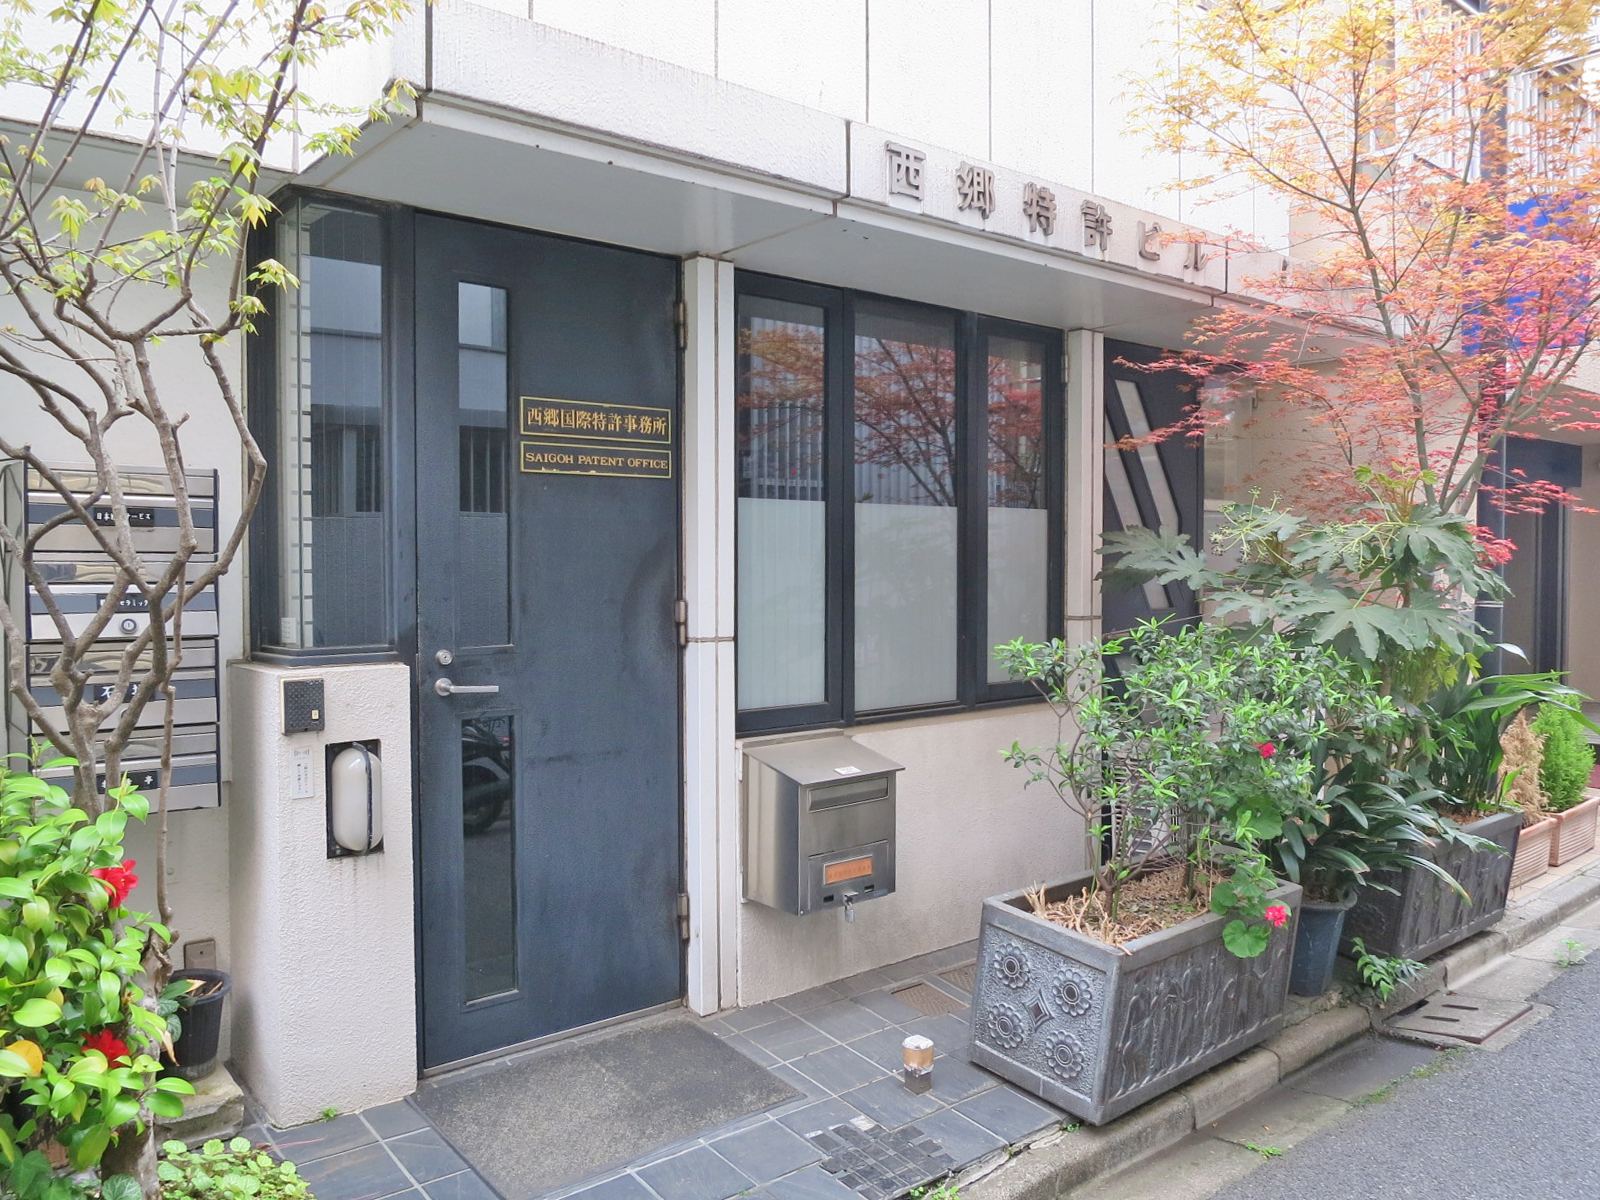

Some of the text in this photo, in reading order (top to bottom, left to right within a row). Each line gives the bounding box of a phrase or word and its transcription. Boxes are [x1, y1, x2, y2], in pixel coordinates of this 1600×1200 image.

[885, 141, 1208, 271] 西郷特許ビル
[527, 407, 667, 435] 西郷国際特許事務所
[525, 452, 668, 470] SAIGOH PATENT OFFICE
